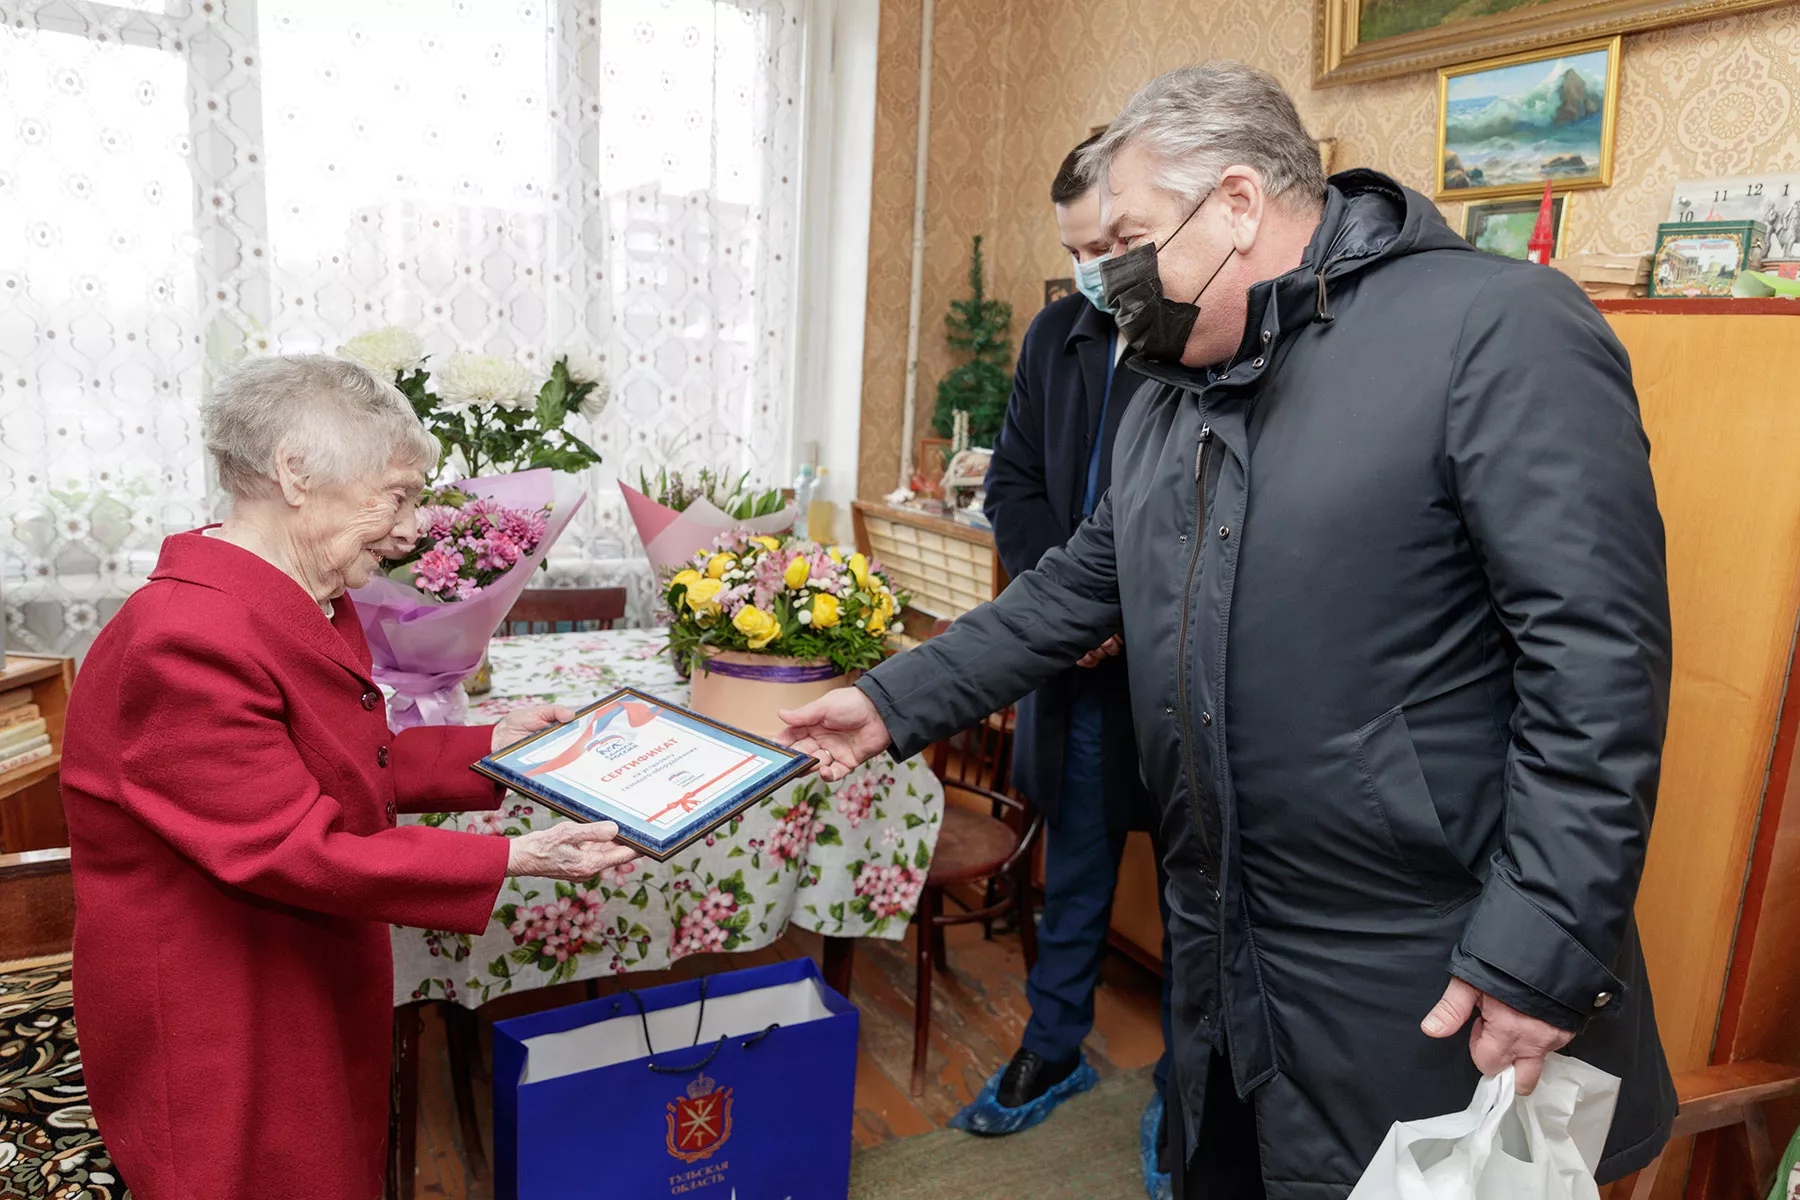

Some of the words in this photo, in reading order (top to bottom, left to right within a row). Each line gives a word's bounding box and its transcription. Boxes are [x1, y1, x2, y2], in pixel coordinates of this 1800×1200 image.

[1713, 190, 1728, 203] 11
[1746, 183, 1764, 197] 12
[1781, 183, 1790, 197] 1
[1679, 211, 1694, 222] 10
[600, 737, 679, 783] СЕРТИФИКАТ
[668, 1160, 729, 1185] ТУЛЬСКАЯ
[671, 1173, 725, 1196] ОБЛАСТЬ
